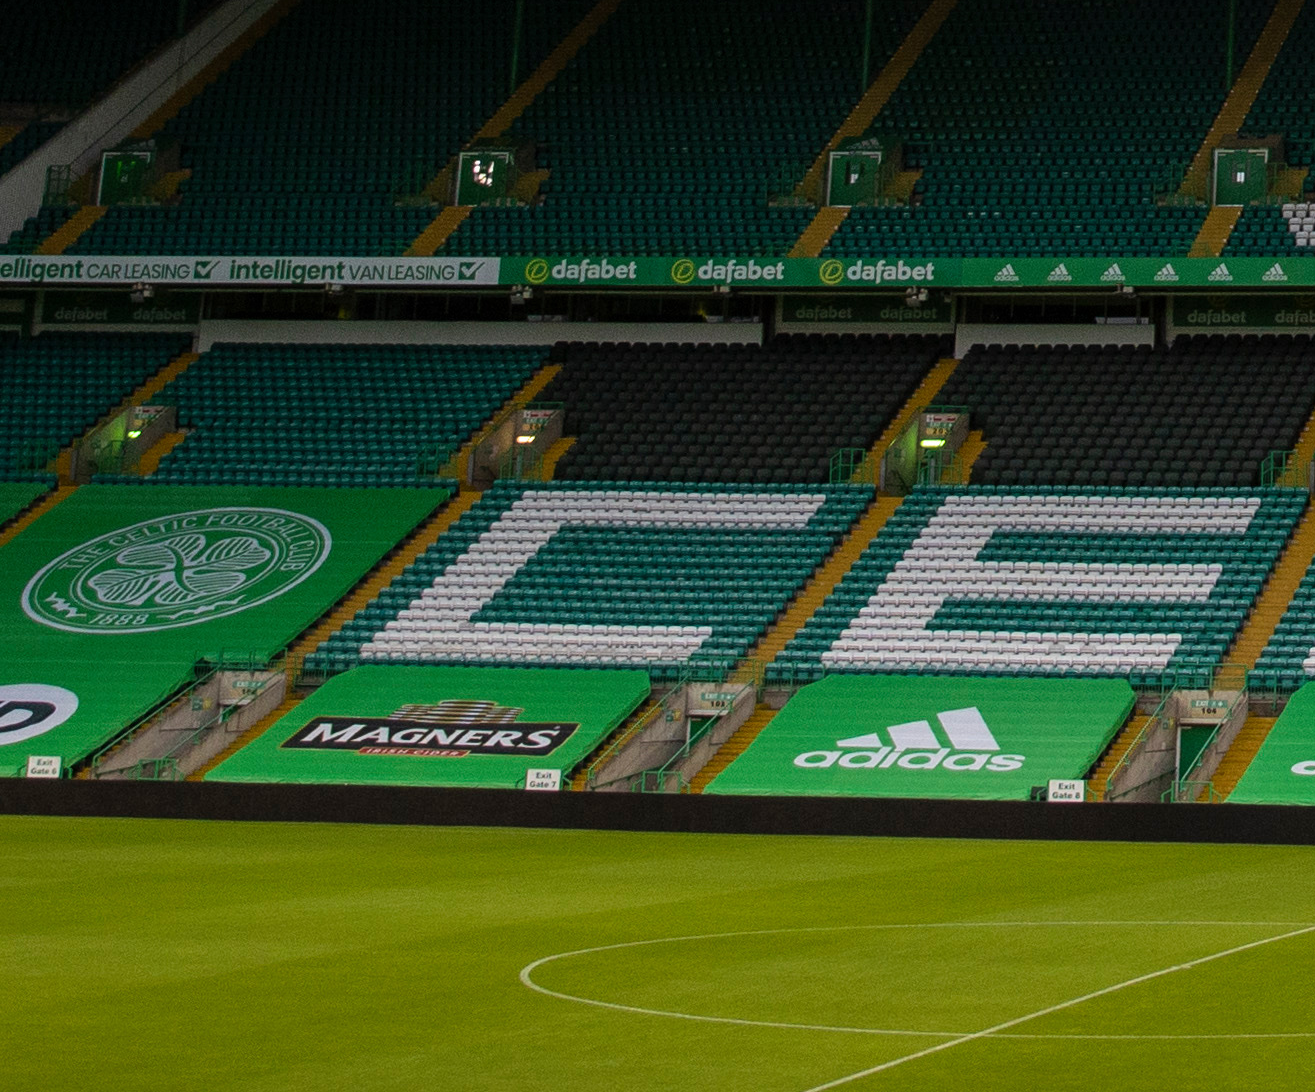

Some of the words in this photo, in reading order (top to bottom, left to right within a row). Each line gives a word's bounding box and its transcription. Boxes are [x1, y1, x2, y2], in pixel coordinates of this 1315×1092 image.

[86, 263, 121, 280] CAR
[124, 263, 190, 280] LEASING
[229, 258, 345, 285] intelligent
[348, 263, 385, 281] VAN
[387, 263, 456, 282] LEASING
[551, 259, 637, 285] dafabet
[698, 259, 785, 284] dafabet
[846, 259, 935, 284] dafabet
[1187, 309, 1246, 325] dafabet
[59, 546, 110, 569] THE
[108, 517, 198, 546] CELTIC
[205, 514, 310, 542] FOOTBALL
[280, 540, 314, 570] CLUB
[89, 613, 149, 626] 1888
[300, 723, 558, 748] MAGNERS
[793, 746, 1026, 772] adidas
